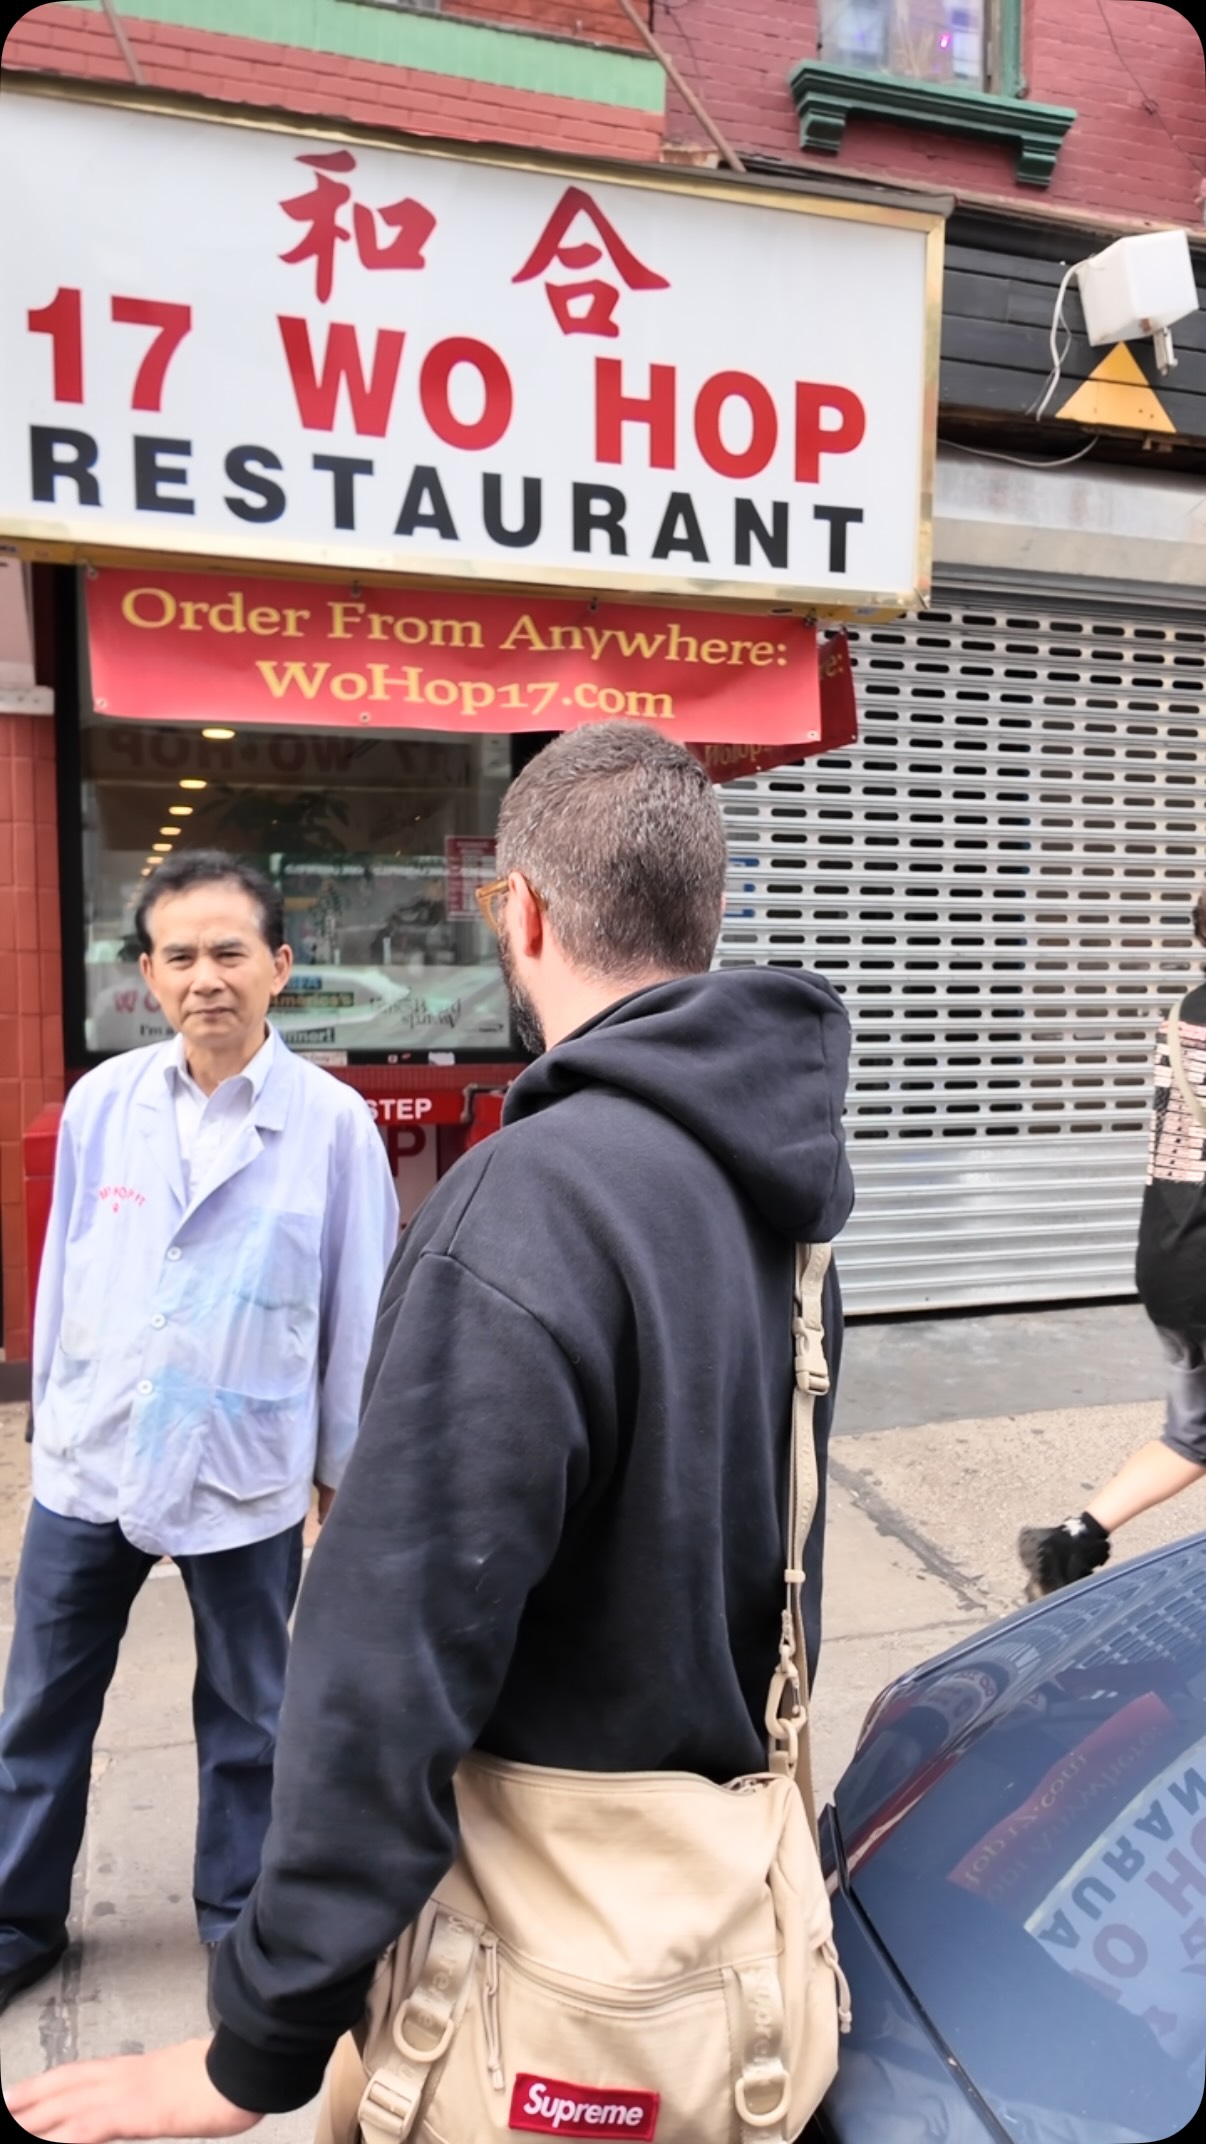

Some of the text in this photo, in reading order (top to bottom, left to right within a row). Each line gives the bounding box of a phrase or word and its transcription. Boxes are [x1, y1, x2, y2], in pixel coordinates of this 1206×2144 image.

[27, 286, 867, 483] 17 WO HOP
[29, 425, 864, 573] RESTAURANT
[121, 588, 788, 667] Order From Anywhere:
[255, 659, 676, 719] WoHop17.com
[365, 1098, 432, 1120] STEP
[523, 2083, 643, 2128] Supreme
